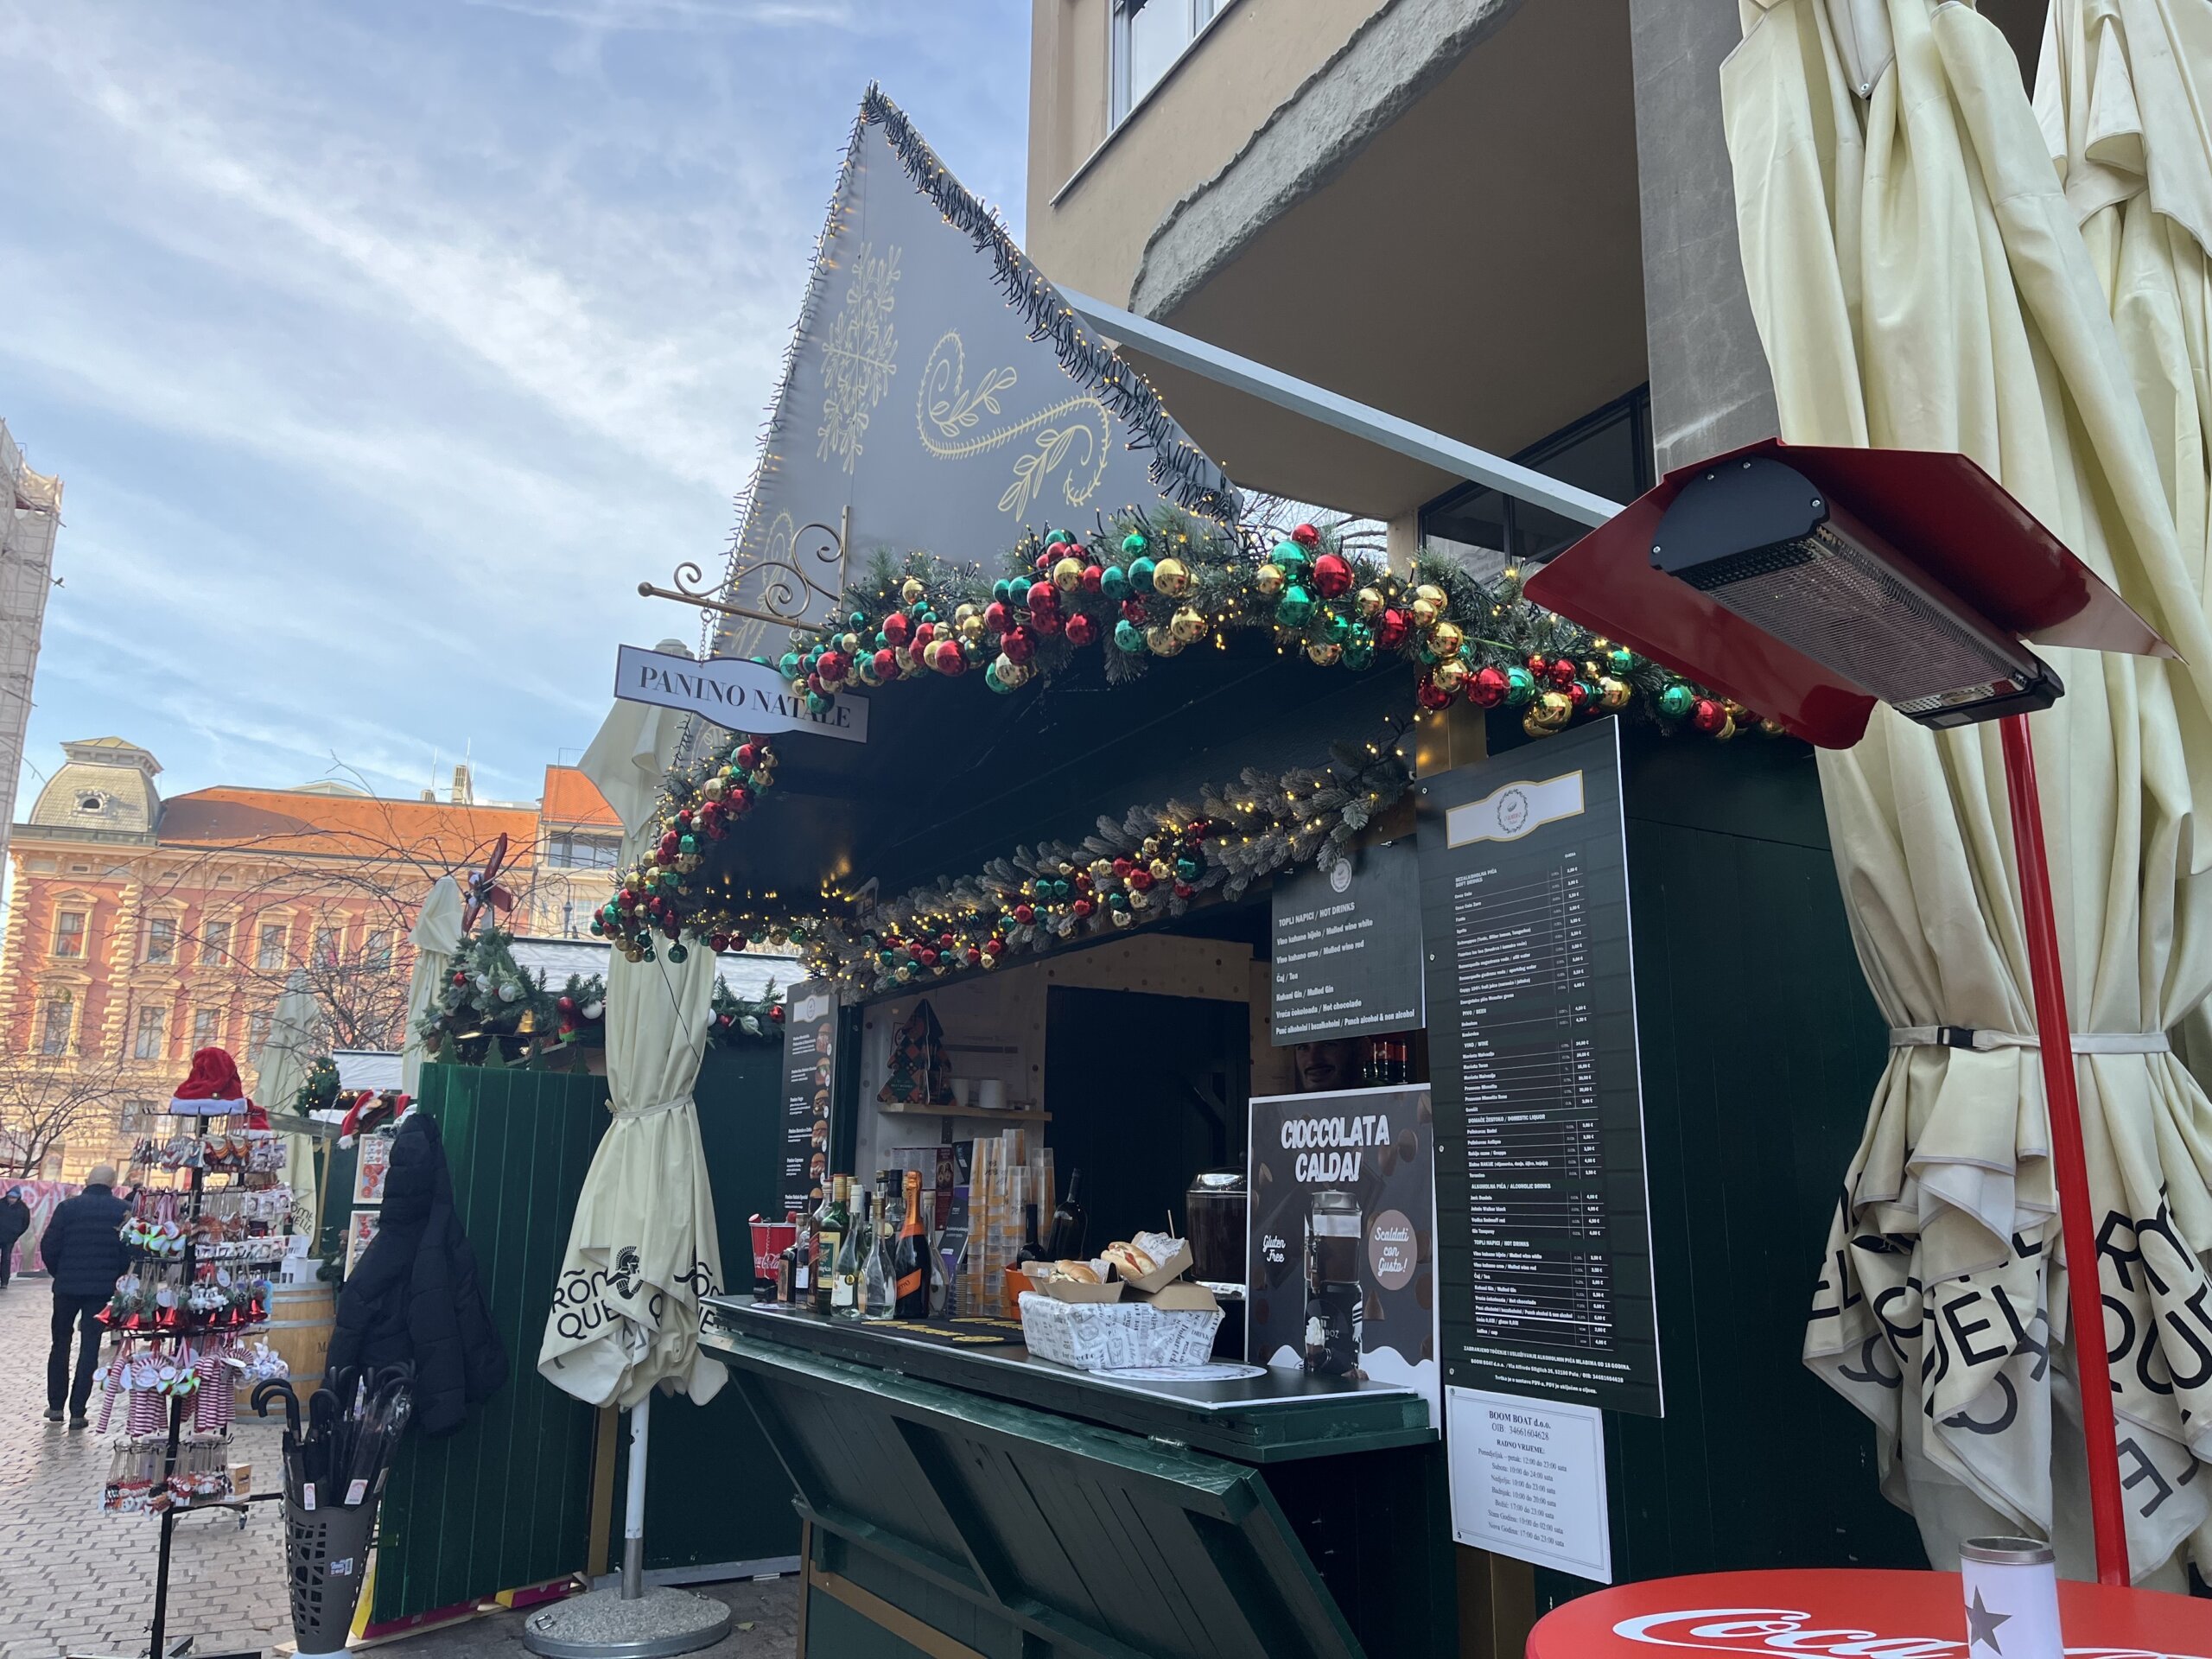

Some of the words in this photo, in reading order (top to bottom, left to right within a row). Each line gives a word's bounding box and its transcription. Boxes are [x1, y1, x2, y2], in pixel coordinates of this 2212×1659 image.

[639, 665, 745, 706] PANINO
[1278, 916, 1294, 927] TOPLI
[1295, 911, 1313, 923] NAPICI
[1319, 907, 1332, 918] HOT
[1332, 901, 1355, 914] DRINKS
[1277, 936, 1287, 945] Vino
[1325, 924, 1343, 935] Mulled
[1344, 921, 1357, 931] wine
[1357, 917, 1372, 928] white
[1276, 955, 1287, 963] Vino
[1323, 944, 1340, 954] Mulled
[1342, 941, 1353, 950] wine
[1355, 939, 1363, 948] red
[1289, 971, 1298, 980] Tea
[1275, 991, 1293, 1001] Kuhani
[1294, 989, 1302, 998] Gin
[1306, 986, 1324, 996] Mulled
[1325, 984, 1333, 993] Gin
[1322, 1002, 1332, 1012] Hot
[1344, 1015, 1359, 1026] Punch
[1360, 1014, 1378, 1023] alcohol
[1395, 1008, 1414, 1019] alcohol
[1281, 1115, 1390, 1149] CIOCCOLATA
[1295, 1152, 1362, 1182] CALDA!
[1375, 1226, 1409, 1242] Scaldati
[1262, 1235, 1286, 1252] Gluten
[1383, 1246, 1399, 1256] con
[1267, 1249, 1285, 1262] Free
[1378, 1257, 1408, 1276] Gusto!
[1489, 1410, 1510, 1421] BOOM
[1512, 1414, 1532, 1425] BOAT
[1533, 1418, 1550, 1428] d.o.o.
[1491, 1422, 1505, 1433] OIB:
[1509, 1425, 1548, 1440] 34661604628
[1497, 1439, 1516, 1448] RADNO
[1517, 1443, 1545, 1454] VRIJEME:
[1554, 1526, 1563, 1535] sata
[1554, 1539, 1564, 1548] sata
